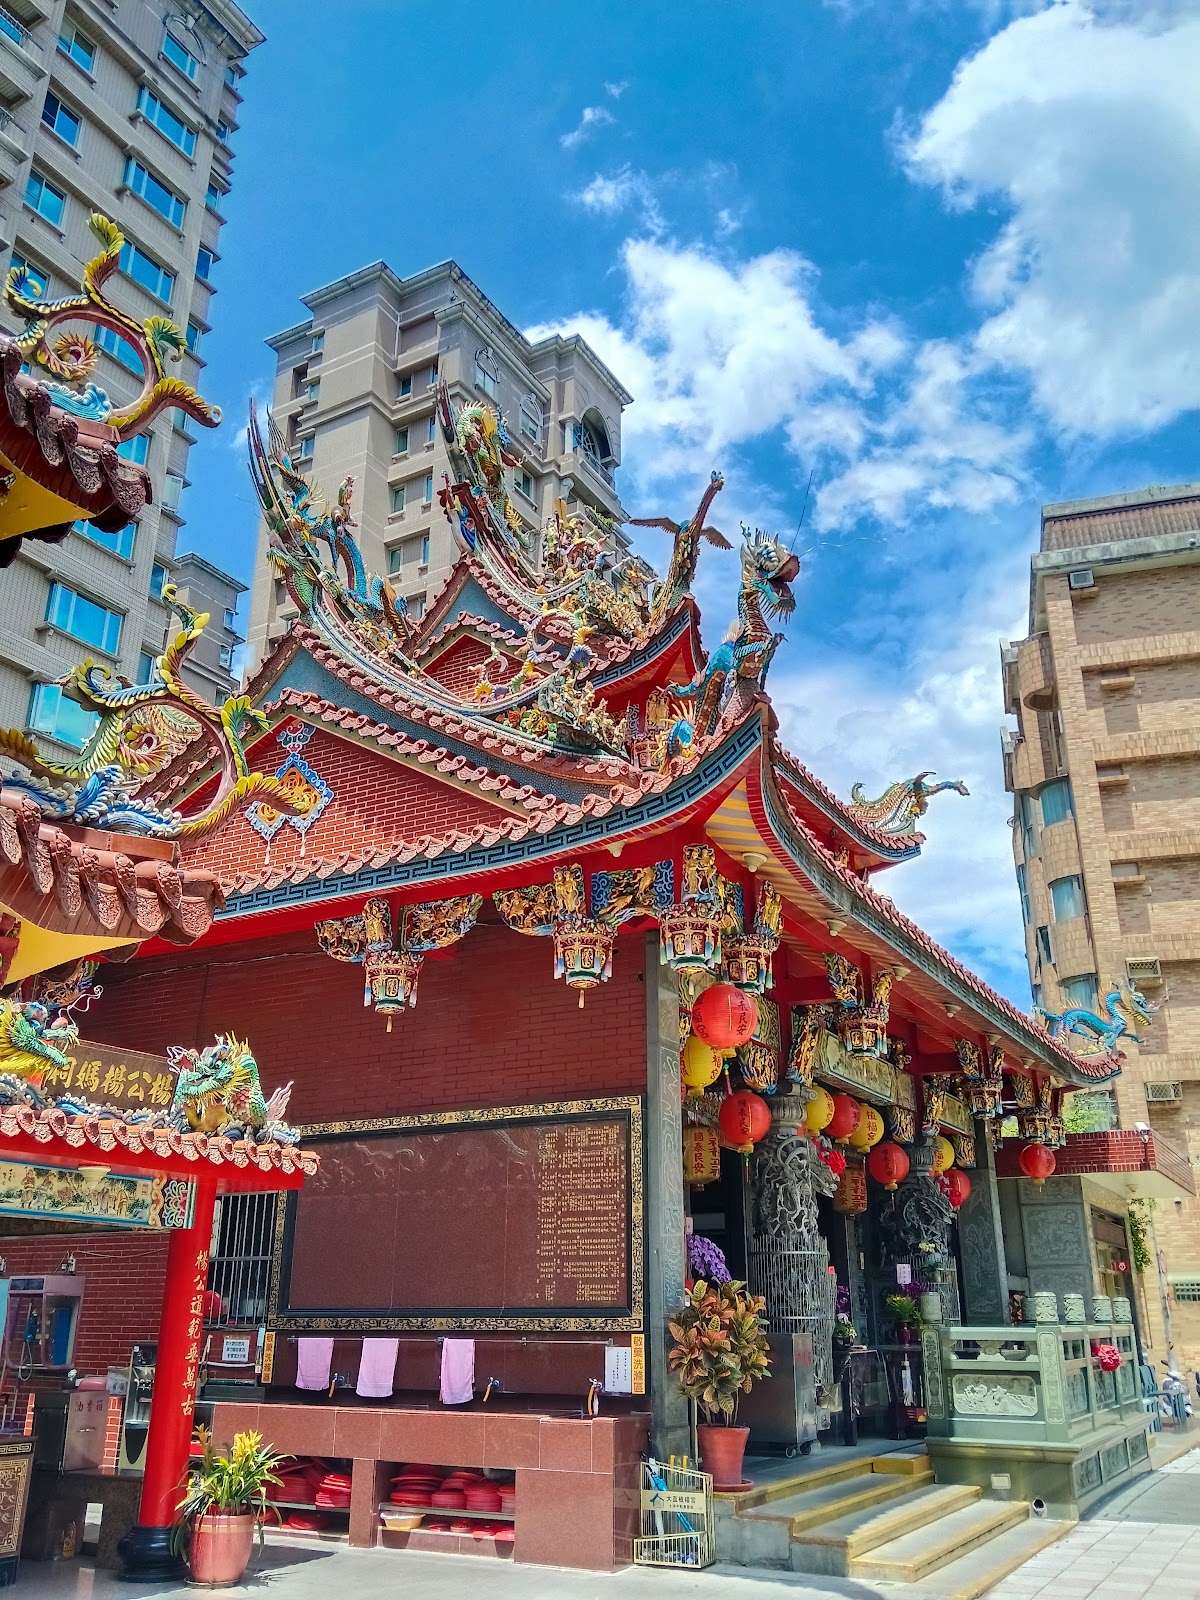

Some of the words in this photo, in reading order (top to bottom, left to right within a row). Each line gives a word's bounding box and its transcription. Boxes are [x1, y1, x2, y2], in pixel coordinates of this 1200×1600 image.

[48, 1056, 174, 1106] 楊公楊媽祠
[866, 1109, 878, 1141] 植福宮
[692, 1131, 706, 1174] 國泰民安
